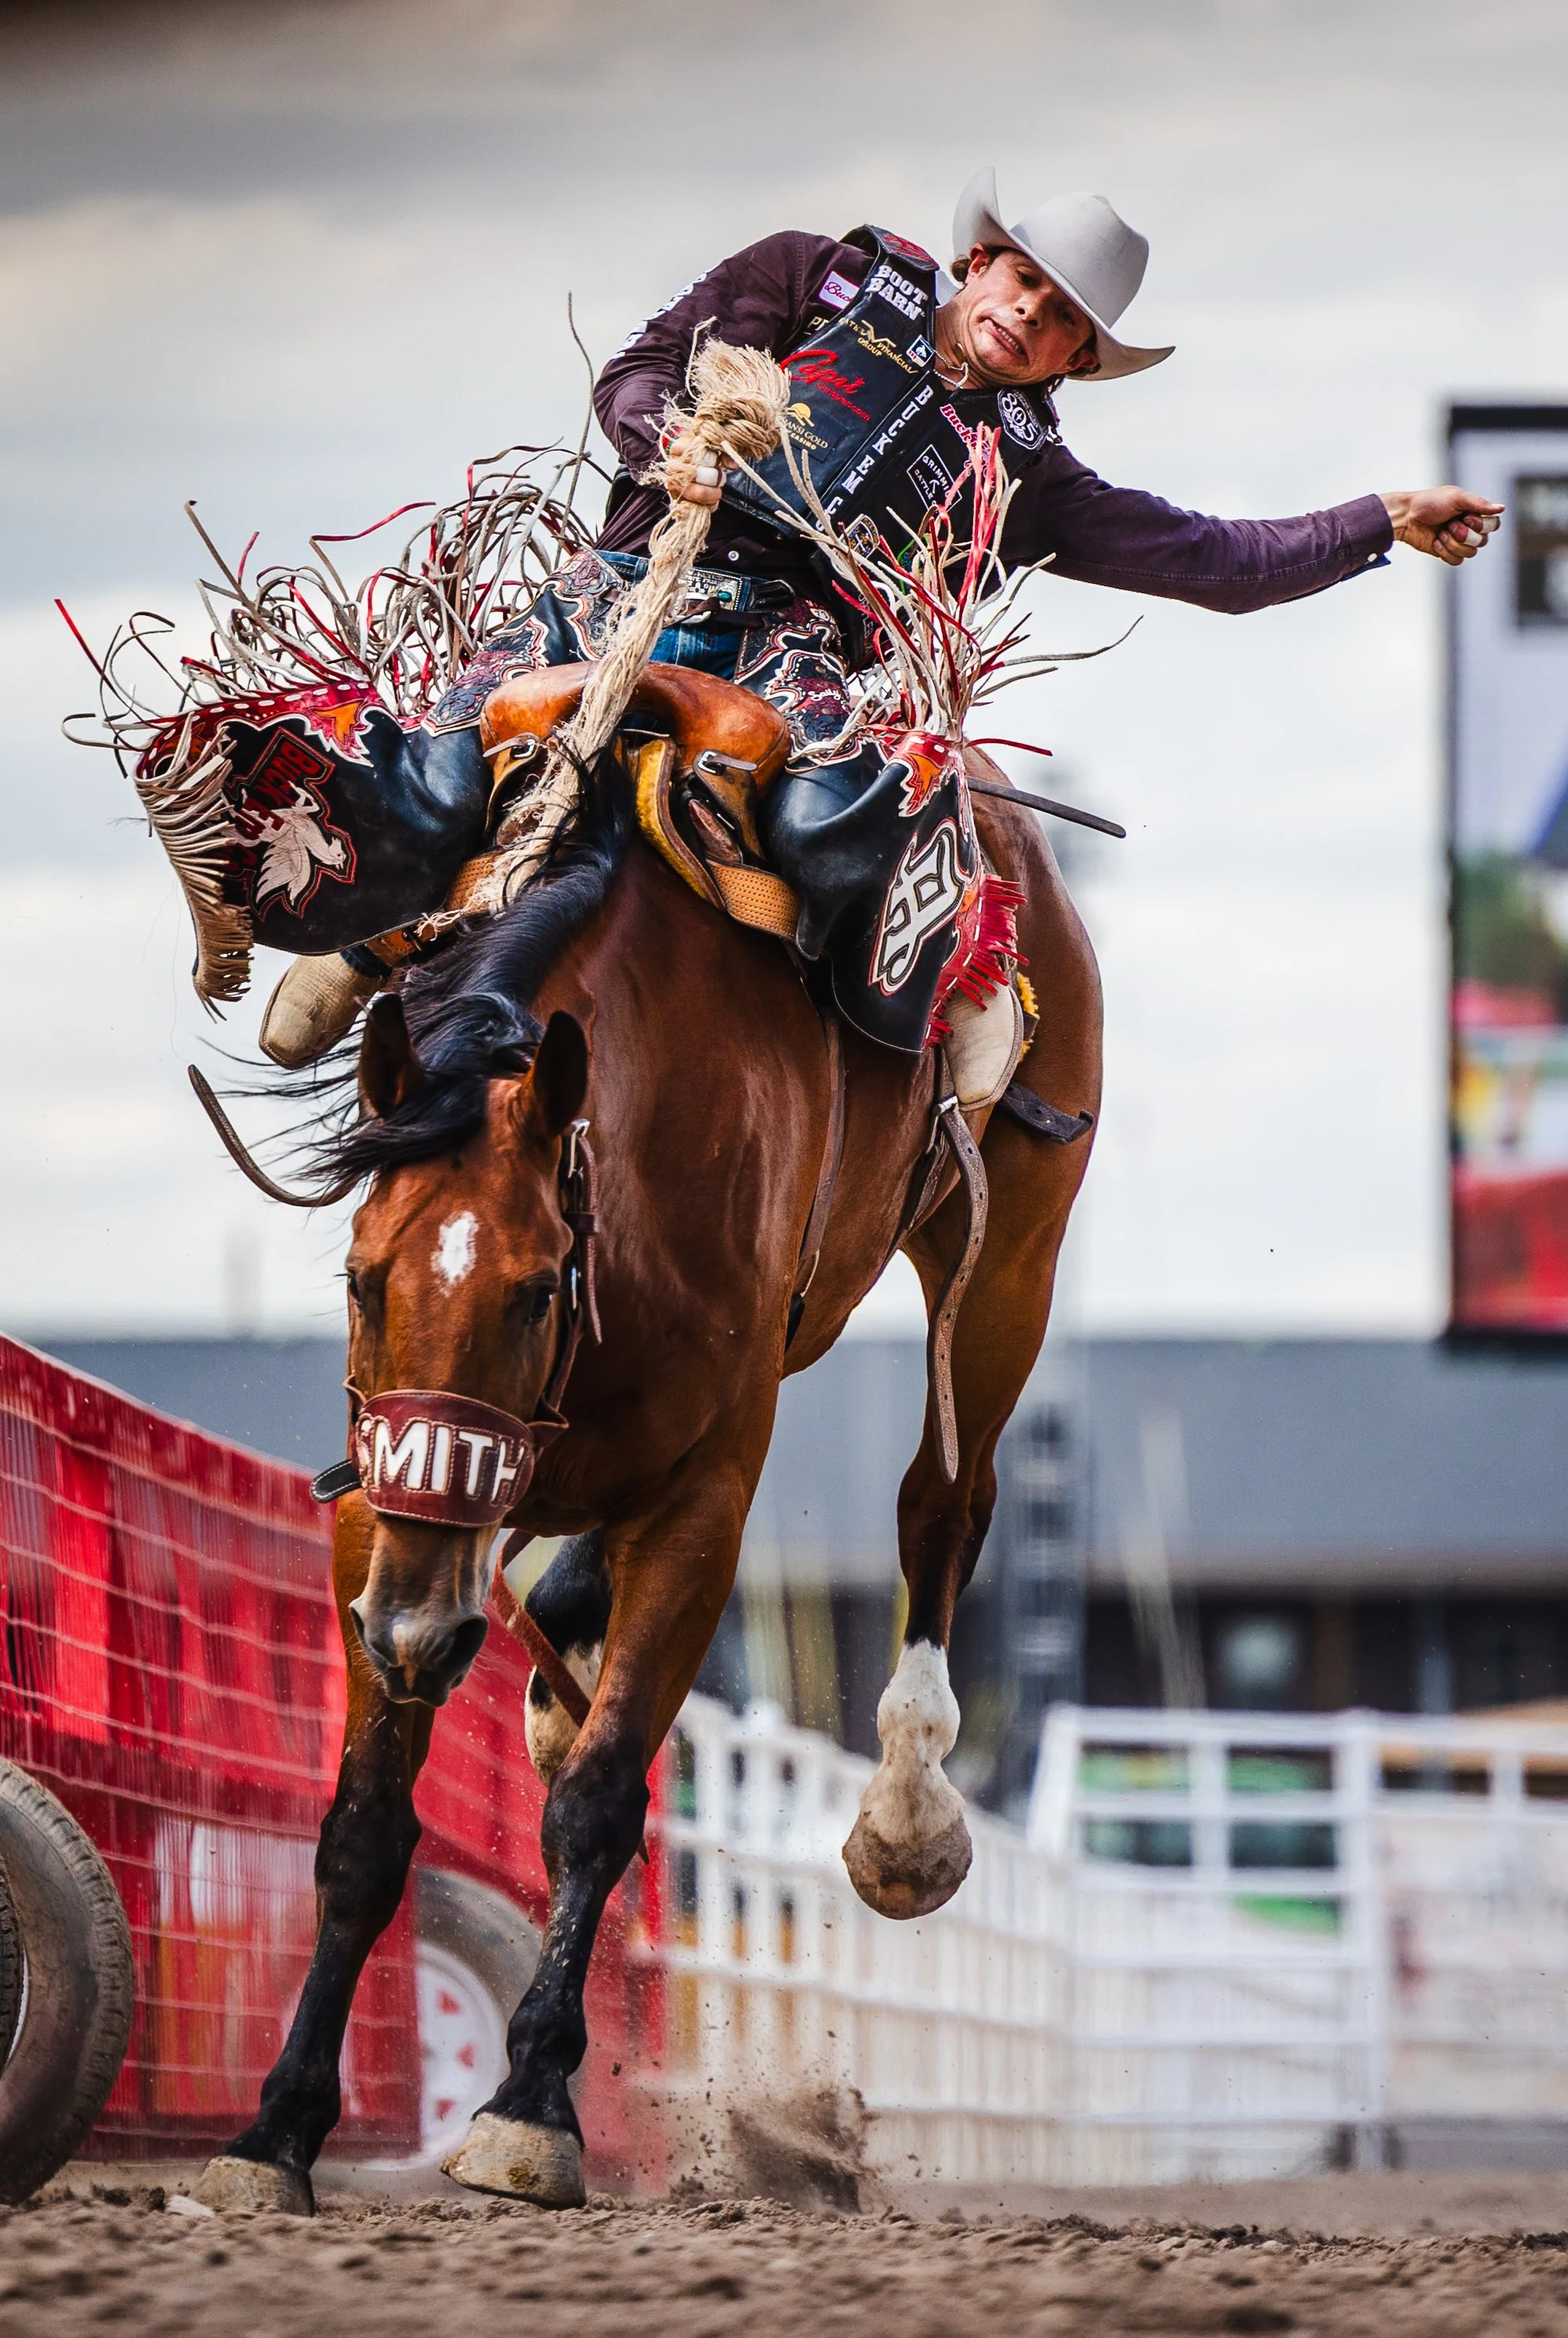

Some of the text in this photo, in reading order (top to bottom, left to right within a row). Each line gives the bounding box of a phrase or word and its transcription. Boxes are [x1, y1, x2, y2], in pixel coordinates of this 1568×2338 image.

[864, 277, 922, 321] BARN
[875, 264, 929, 305] BOOT
[1001, 392, 1040, 441] 805
[790, 432, 817, 451] CASINO
[804, 431, 828, 449] GOLD
[914, 468, 934, 499] CATTLE
